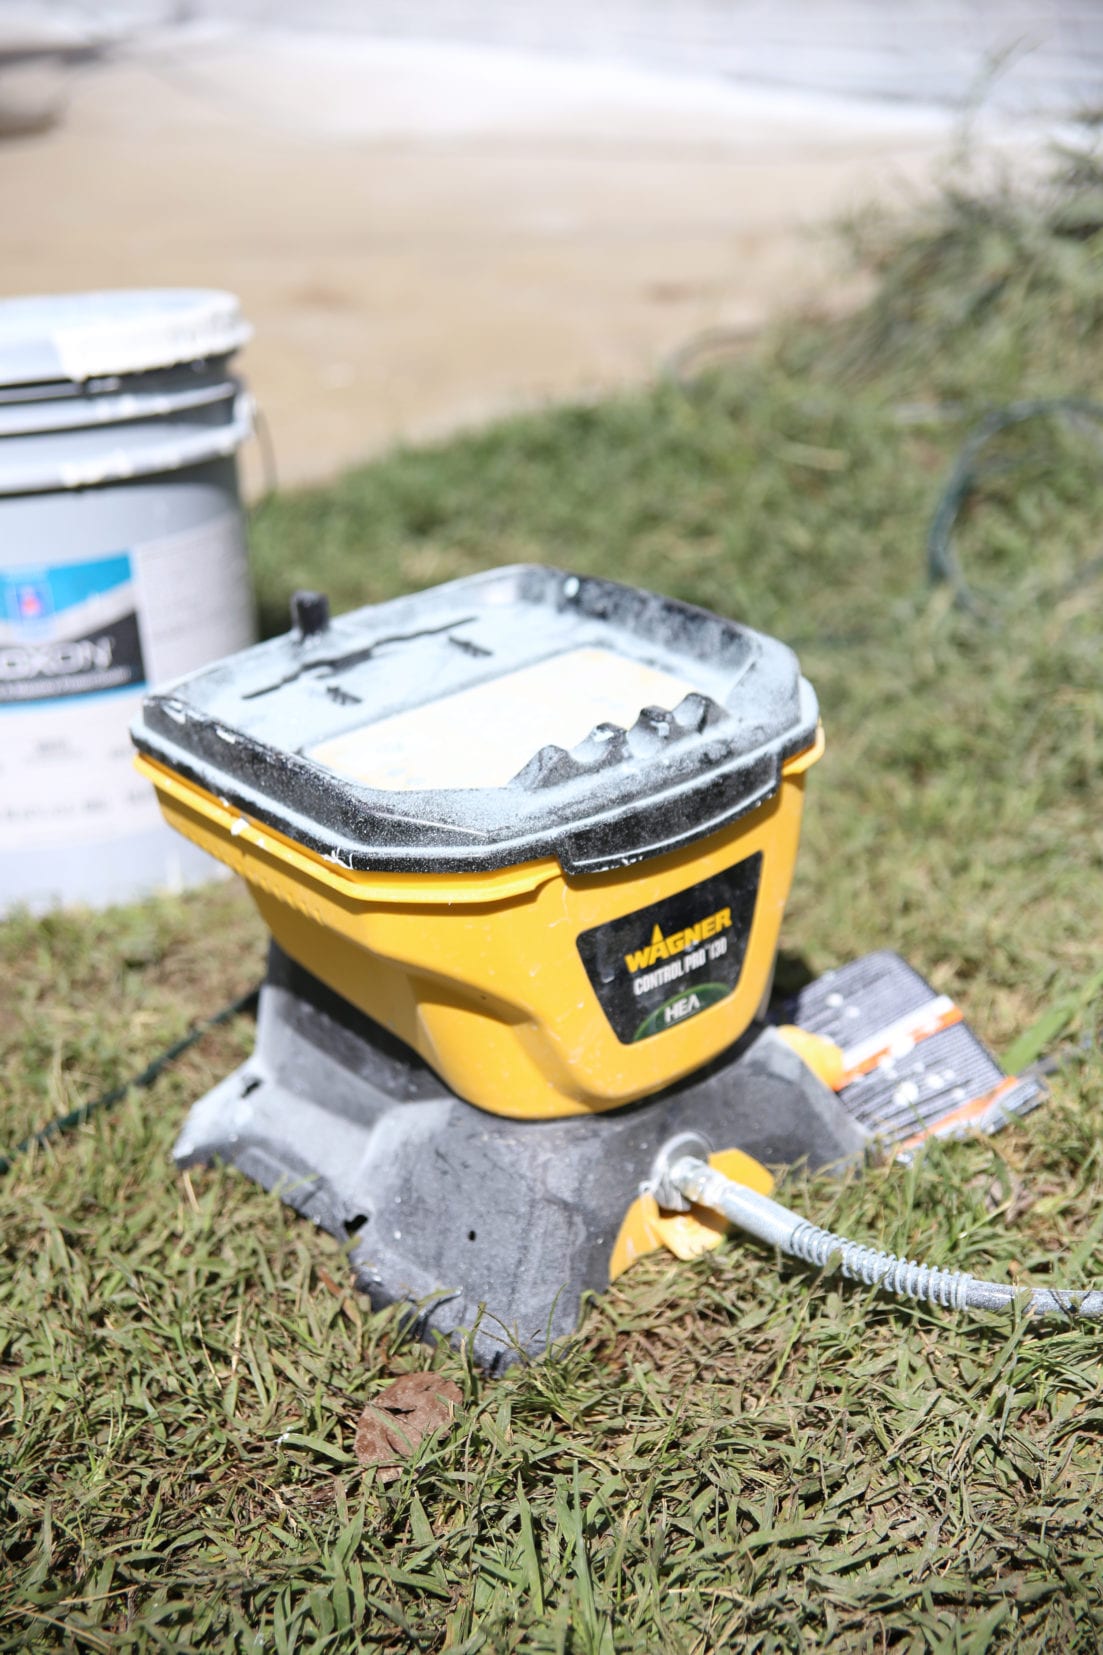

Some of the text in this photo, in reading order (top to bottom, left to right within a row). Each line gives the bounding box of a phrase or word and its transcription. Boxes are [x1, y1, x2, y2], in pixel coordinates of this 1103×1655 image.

[625, 907, 732, 973] WAGNER
[633, 961, 684, 995] CONTROL
[665, 993, 700, 1023] HEA
